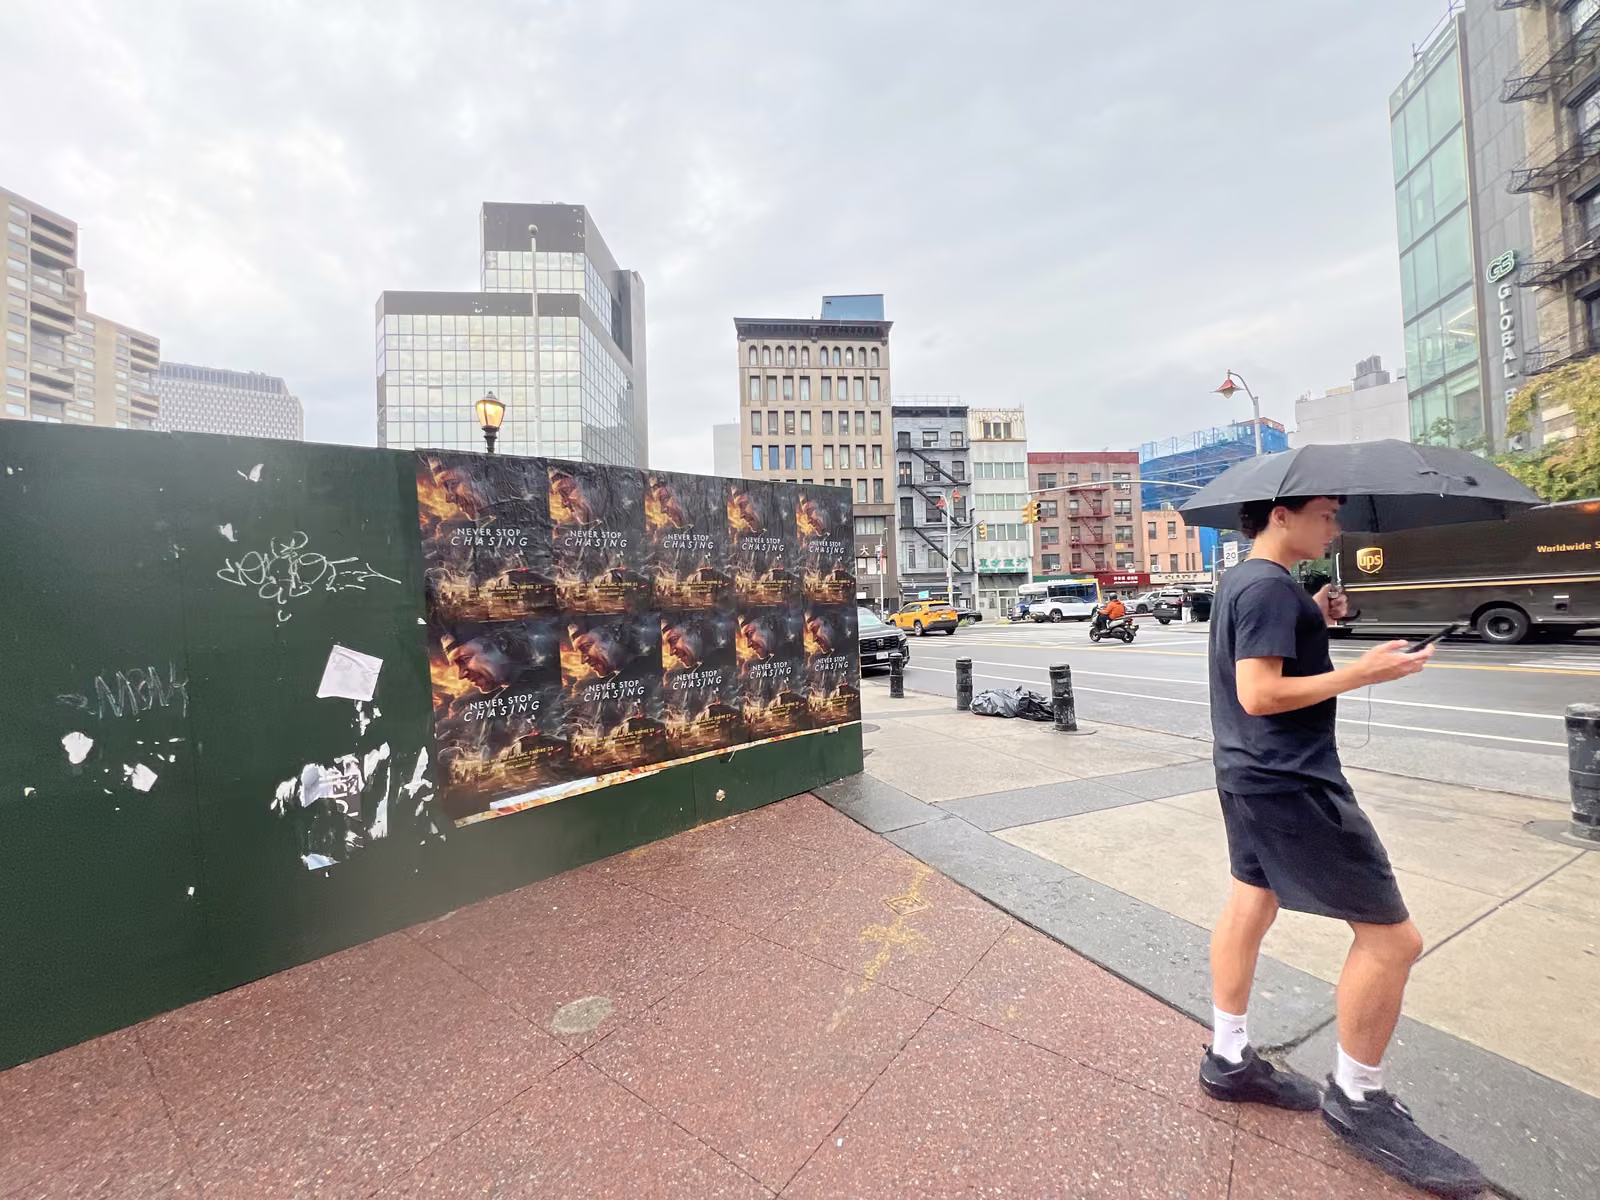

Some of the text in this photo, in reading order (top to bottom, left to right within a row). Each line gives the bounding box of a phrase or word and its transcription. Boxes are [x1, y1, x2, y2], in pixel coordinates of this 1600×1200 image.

[1498, 283, 1517, 379] GLOBAL
[457, 528, 521, 537] NEVER STOP
[570, 530, 622, 539] NEVER STOP
[692, 534, 709, 542] STOP
[451, 536, 529, 547] CHASING
[564, 538, 628, 548] CHASING
[663, 540, 714, 550] CHASING
[1537, 541, 1592, 553] Worldwide
[741, 543, 785, 552] CHASING
[809, 546, 845, 554] CHASING
[1225, 552, 1237, 560] 20
[1358, 554, 1382, 569] ups
[752, 661, 788, 672] NEVER STOP
[814, 661, 849, 672] CHASING
[676, 670, 718, 681] NEVER STOP
[750, 667, 792, 679] CHASING
[588, 679, 640, 692] NEVER STOP
[672, 675, 722, 690] CHASING
[583, 686, 645, 702] CHASING
[469, 693, 533, 711] NEVER STOP
[463, 700, 540, 722] CHASING
